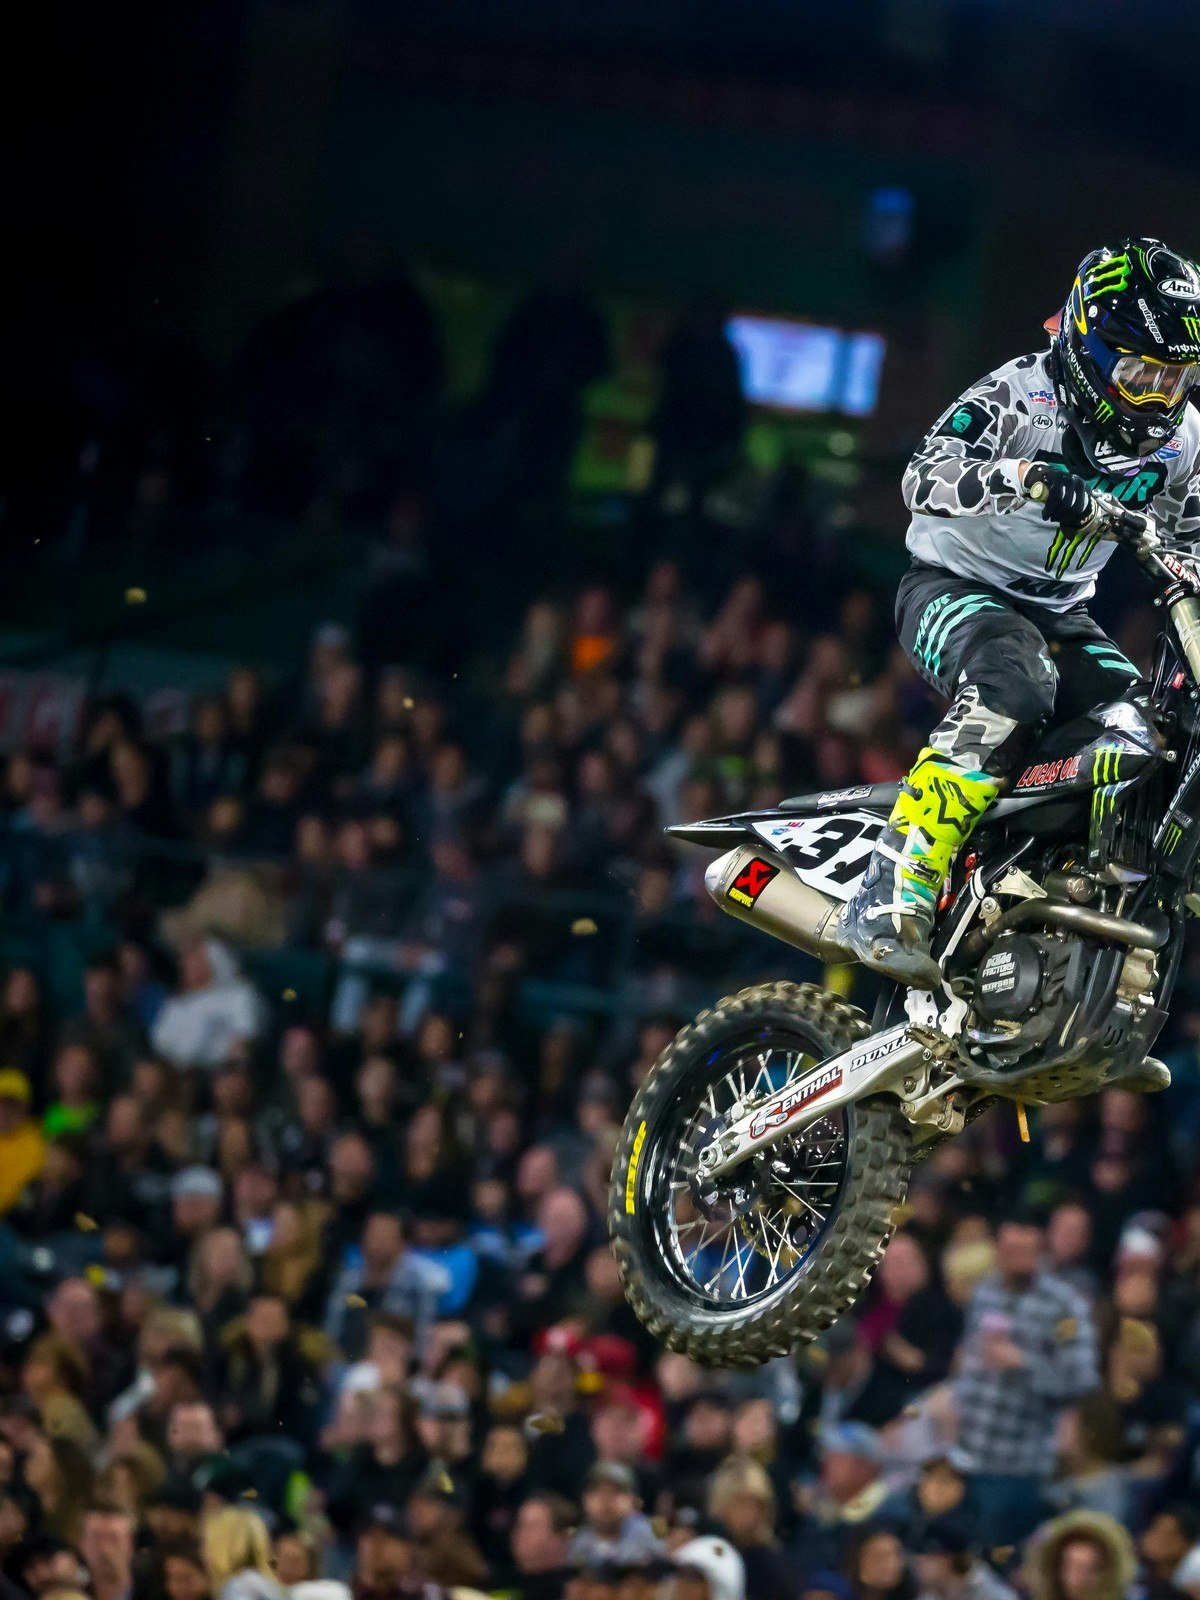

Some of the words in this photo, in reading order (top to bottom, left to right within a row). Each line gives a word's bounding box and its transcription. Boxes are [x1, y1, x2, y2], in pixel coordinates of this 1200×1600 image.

[1162, 280, 1195, 294] Arai
[1016, 759, 1063, 787] LUCAS
[1060, 755, 1082, 780] OIL
[982, 962, 1015, 978] FACTORY
[850, 1035, 912, 1072] DUNLO
